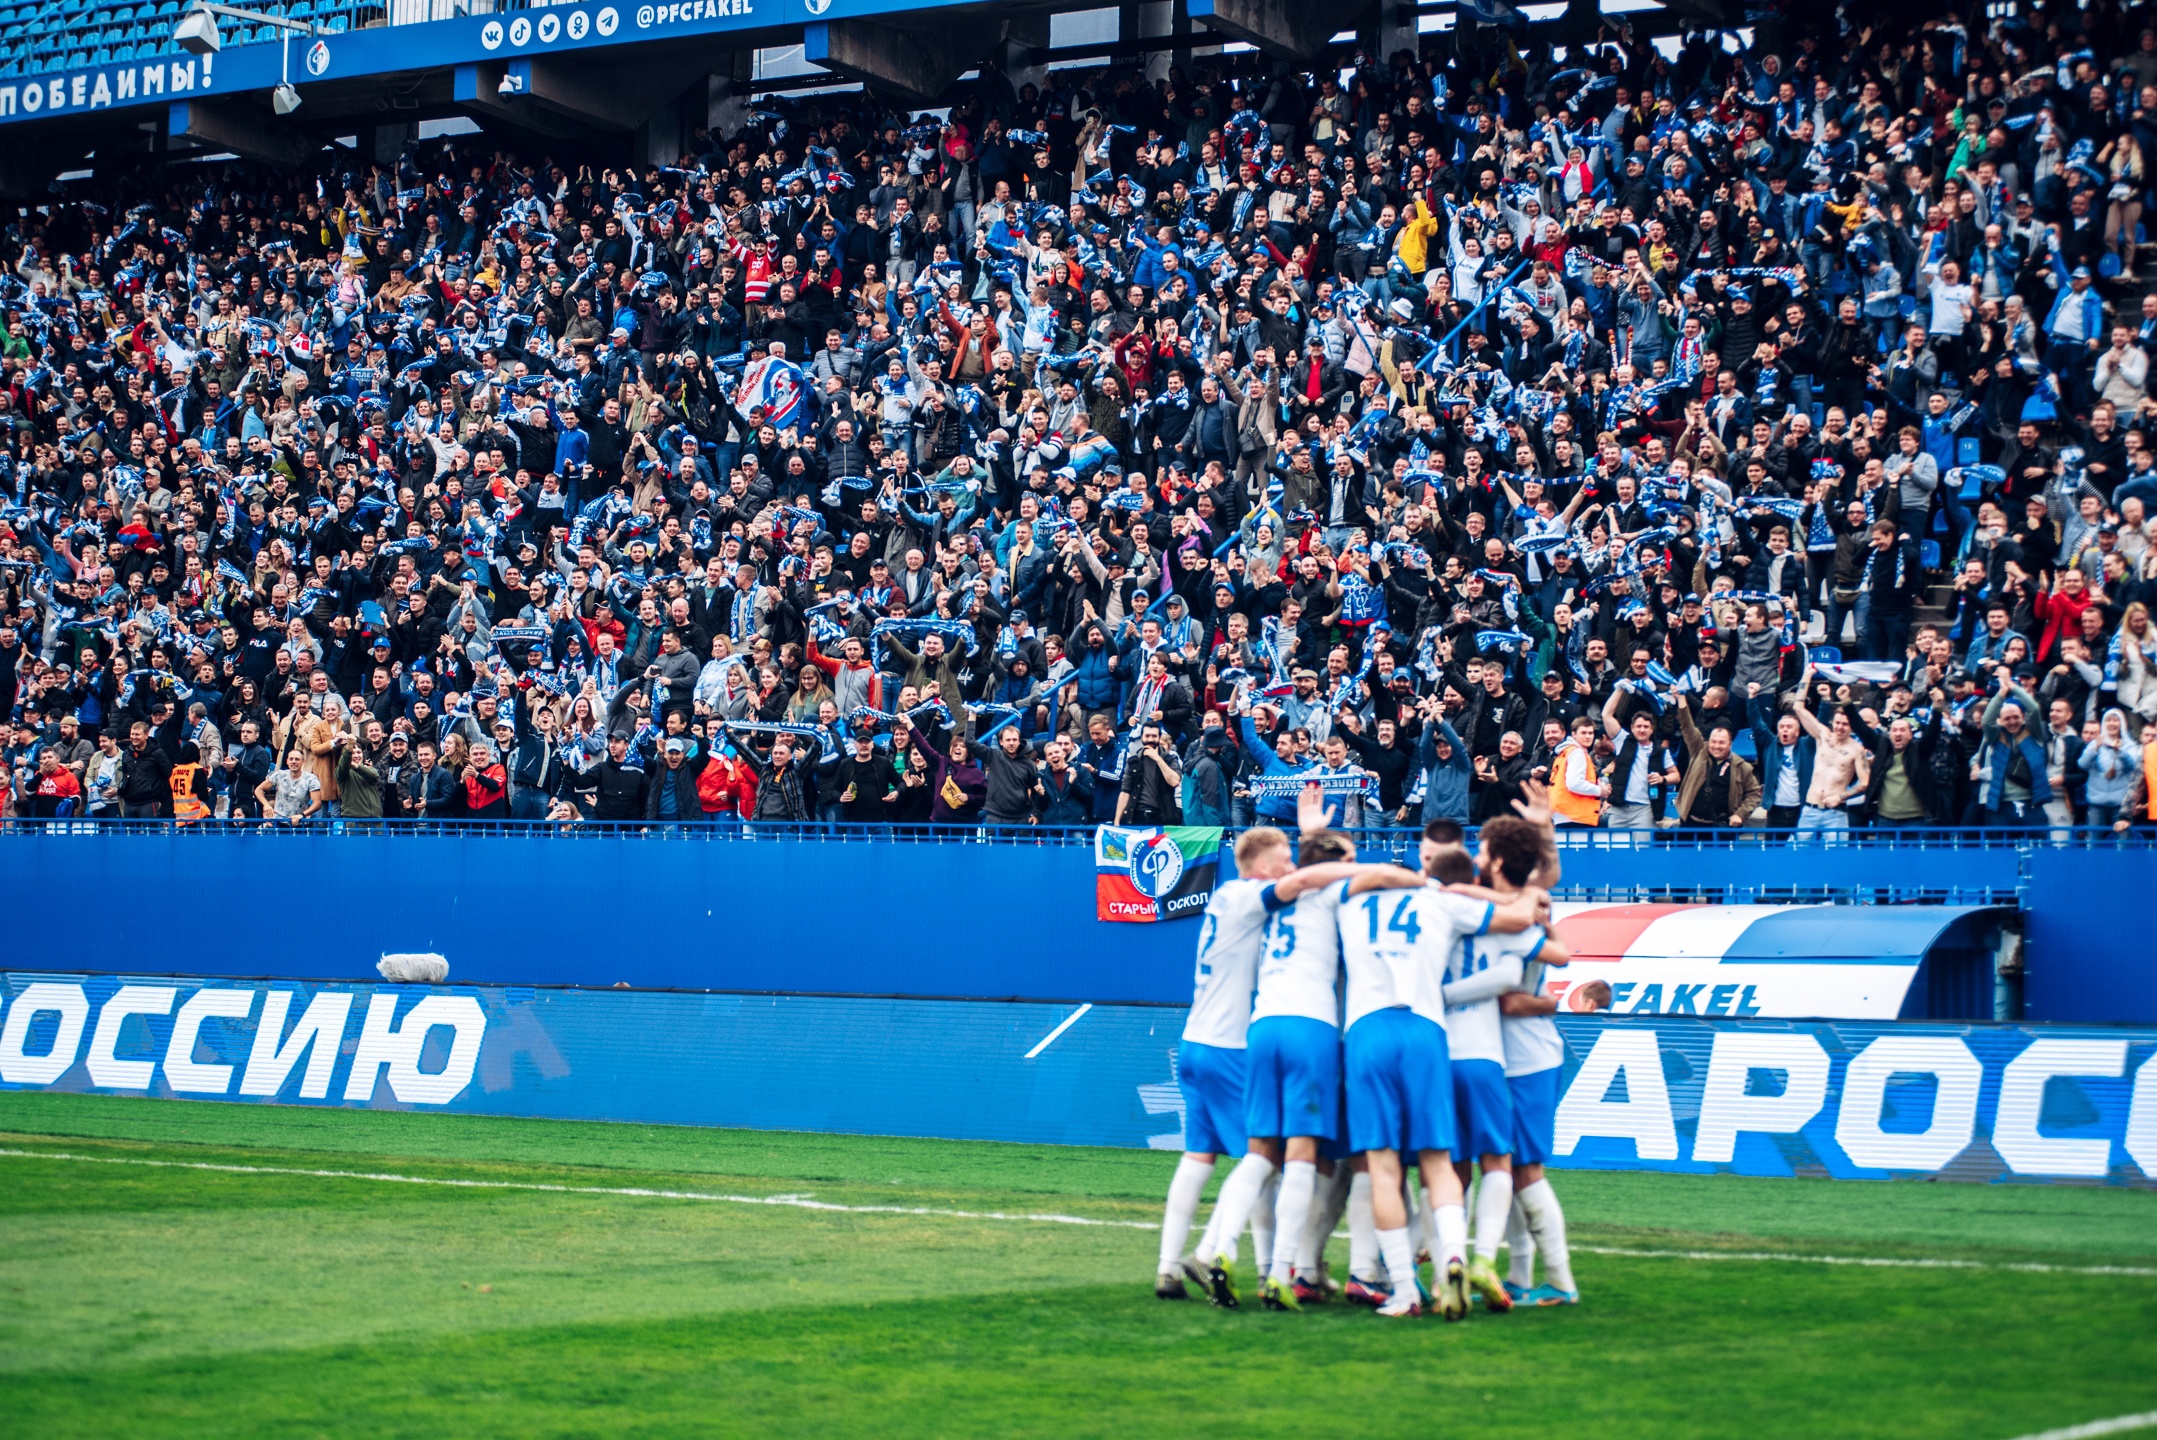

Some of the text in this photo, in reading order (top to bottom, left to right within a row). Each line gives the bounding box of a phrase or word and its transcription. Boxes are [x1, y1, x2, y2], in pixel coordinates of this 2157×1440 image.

[636, 0, 754, 28] @PFCFAKEL
[0, 52, 213, 116] ПОБЕДИМЫ!
[249, 638, 268, 648] FILA
[173, 778, 186, 796] 45
[1109, 900, 1160, 914] СТАРЫЙ
[1167, 892, 1209, 912] ОСКОЛ
[1361, 894, 1422, 945] 14
[1552, 1028, 2157, 1178] АРОС
